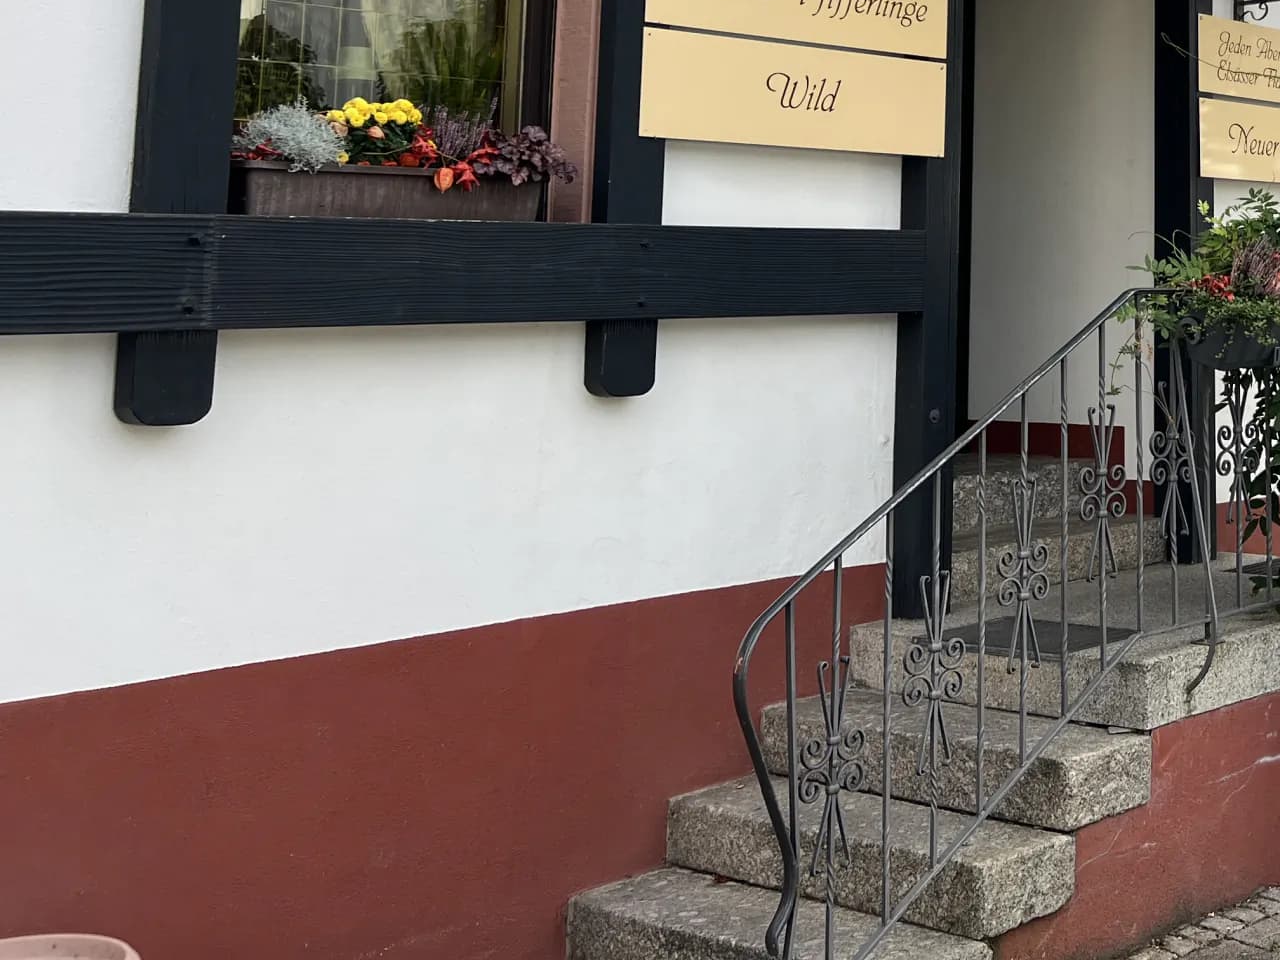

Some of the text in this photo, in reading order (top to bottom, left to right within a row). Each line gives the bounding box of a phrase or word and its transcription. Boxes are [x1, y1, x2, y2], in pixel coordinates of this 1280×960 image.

[1217, 31, 1252, 57] Jeden
[766, 72, 842, 113] Wild
[1228, 123, 1280, 158] Neuer
